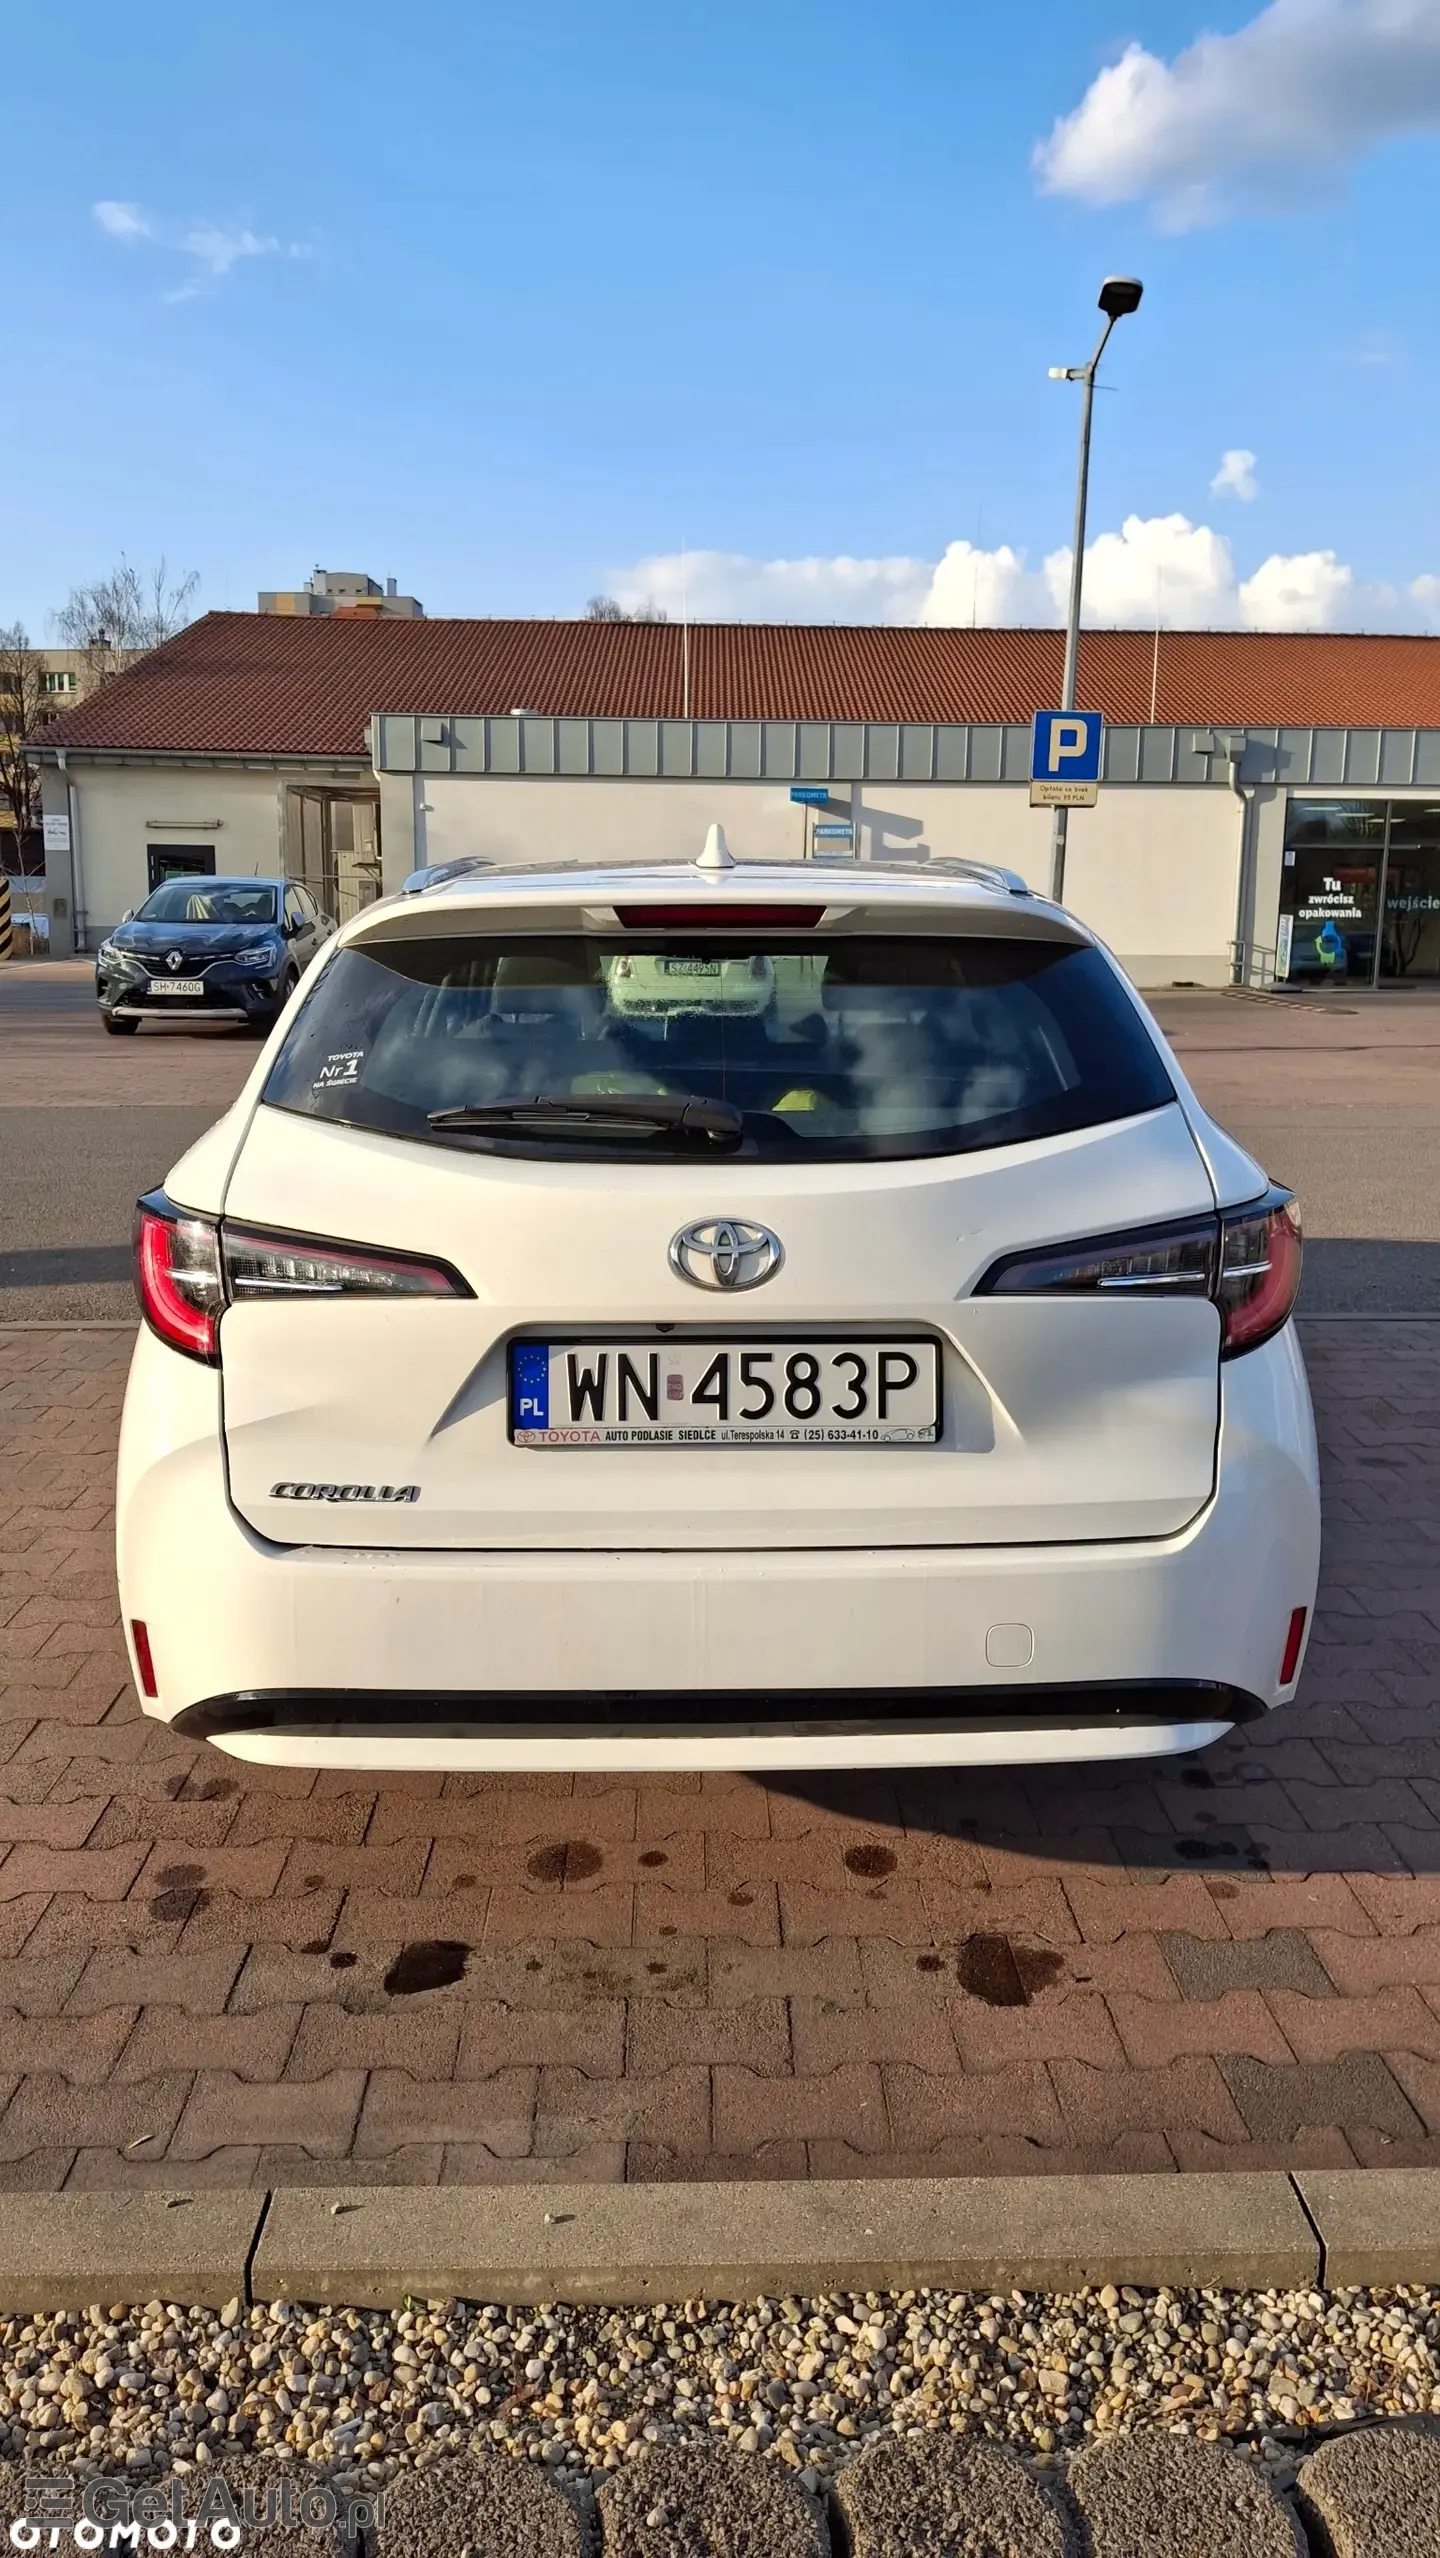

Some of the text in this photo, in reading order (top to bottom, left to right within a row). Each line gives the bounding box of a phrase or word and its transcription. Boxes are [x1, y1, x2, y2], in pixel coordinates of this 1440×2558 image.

[1048, 718, 1087, 772] P
[1323, 877, 1342, 891] Tu
[1308, 893, 1354, 904] zwrócisz
[1387, 895, 1440, 911] wejście
[1299, 907, 1362, 920] opakowania
[328, 1051, 364, 1061] TOYOTA
[566, 1351, 918, 1421] WN 4583P
[519, 1397, 545, 1416] PL
[539, 1431, 600, 1443] TOYOTA
[605, 1430, 628, 1441] AUTO
[631, 1430, 673, 1441] PODLASIE
[678, 1429, 716, 1440] SIEDLCE
[776, 1429, 785, 1440] 14
[804, 1429, 825, 1441] (25)
[828, 1429, 879, 1440] 633-41-10
[268, 1482, 421, 1503] COROLLA
